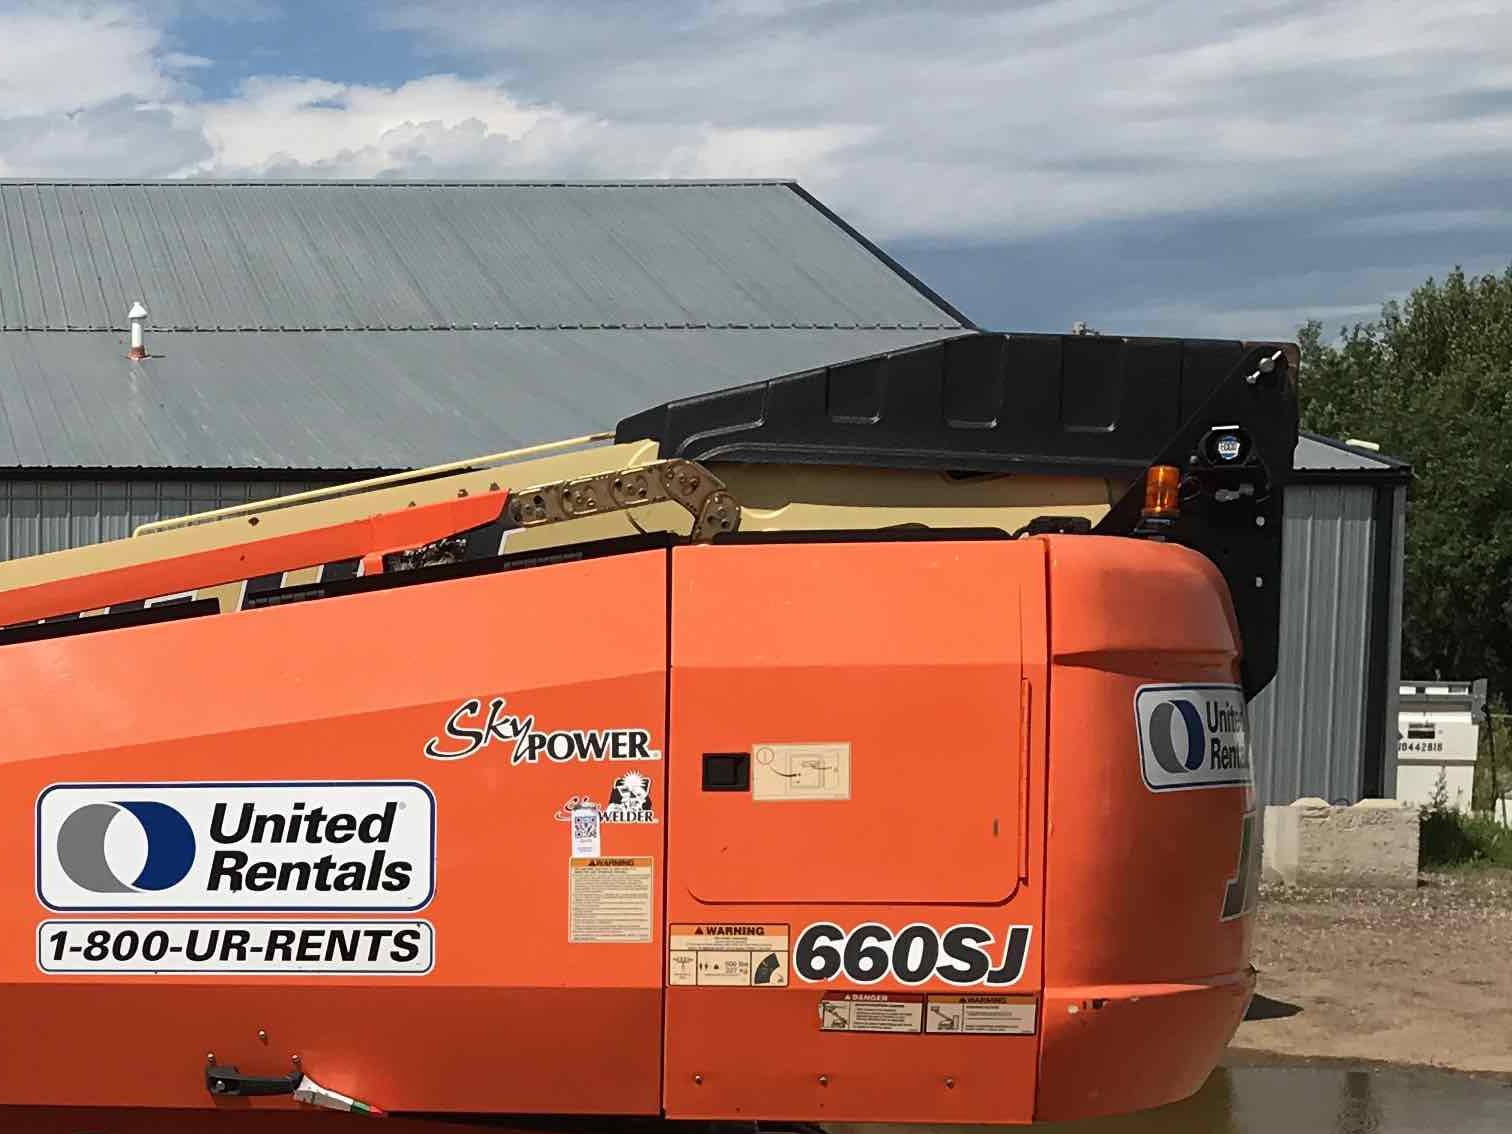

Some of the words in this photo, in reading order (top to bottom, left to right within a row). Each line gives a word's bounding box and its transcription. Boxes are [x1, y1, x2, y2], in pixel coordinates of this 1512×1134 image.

[424, 698, 534, 764] Sky
[527, 731, 651, 761] POWER
[209, 801, 398, 844] United
[599, 811, 653, 822] WELDER
[206, 850, 413, 892] Rentals
[48, 929, 421, 963] 1-800-UR-RENTS
[706, 926, 765, 936] WARNING
[795, 923, 1031, 985] 660SJ
[852, 994, 889, 1002] DANGER
